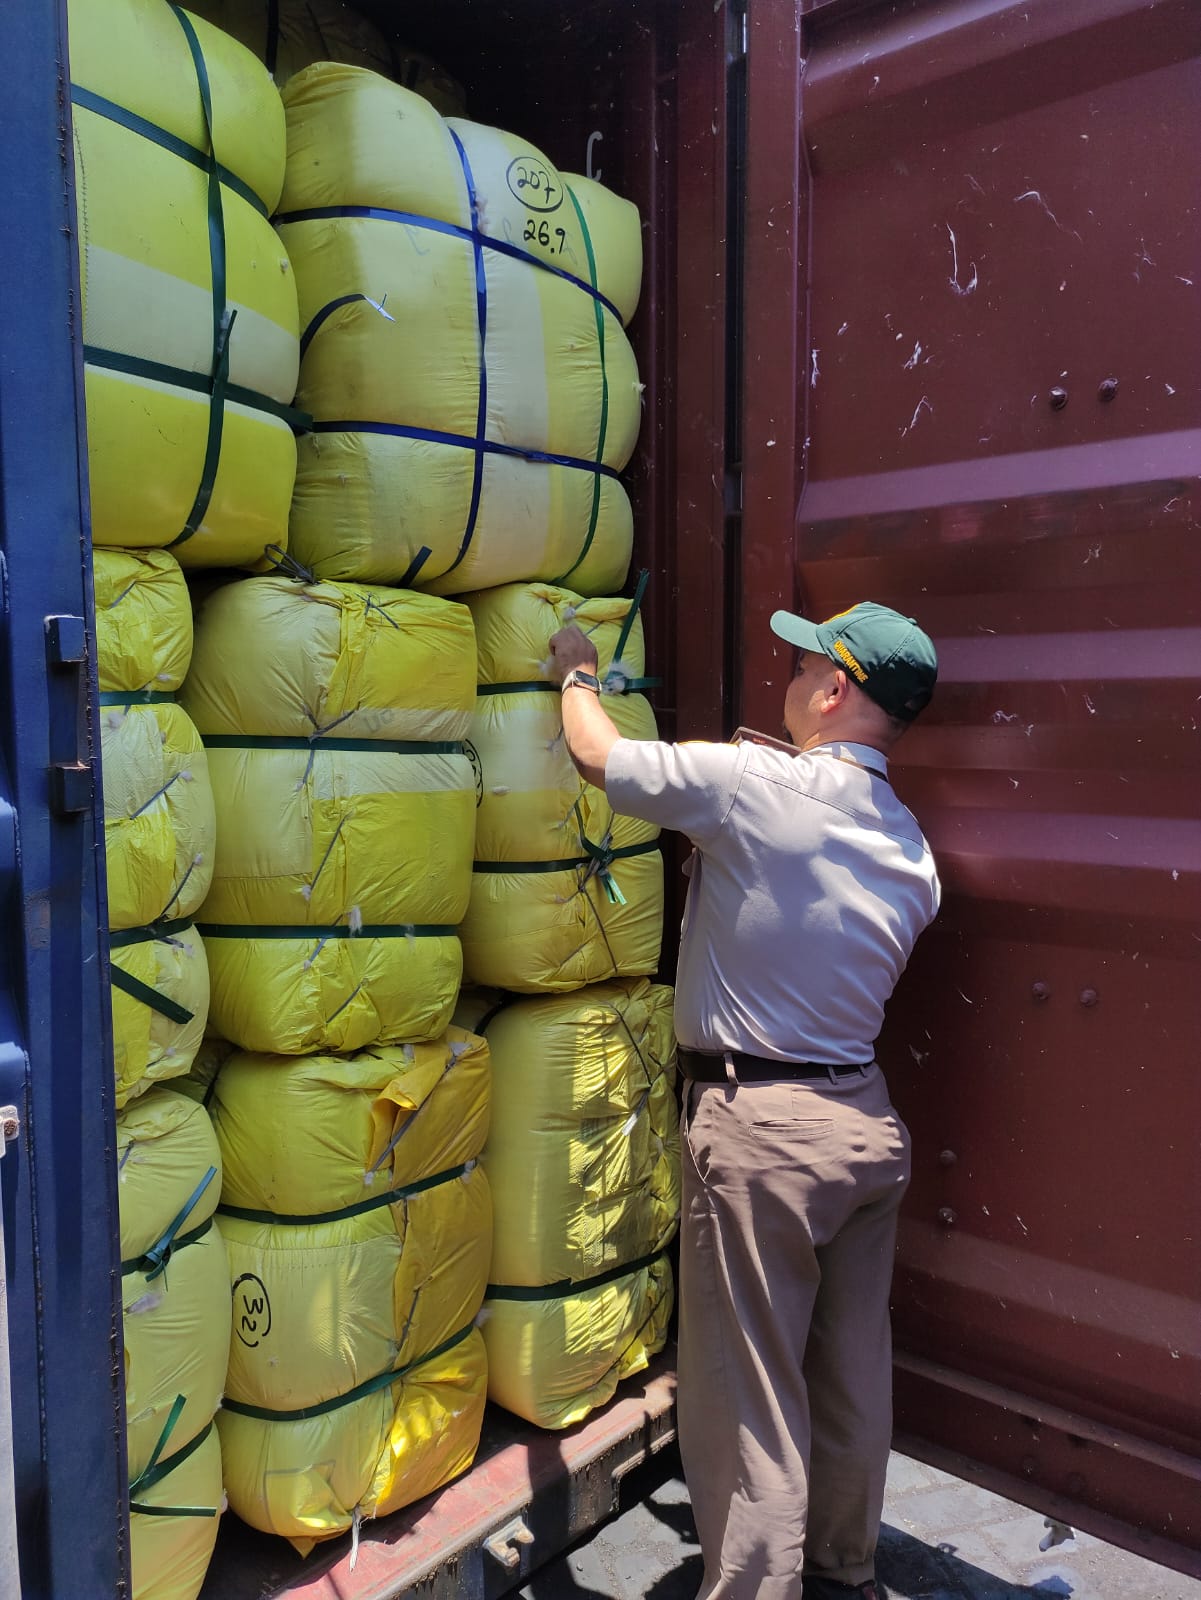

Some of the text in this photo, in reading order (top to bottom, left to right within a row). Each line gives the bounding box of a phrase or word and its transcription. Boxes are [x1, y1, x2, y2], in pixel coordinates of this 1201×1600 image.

[517, 166, 556, 204] 207
[523, 219, 566, 254] 26.9
[834, 639, 869, 683] QUARANTINE
[242, 1294, 263, 1333] 32
